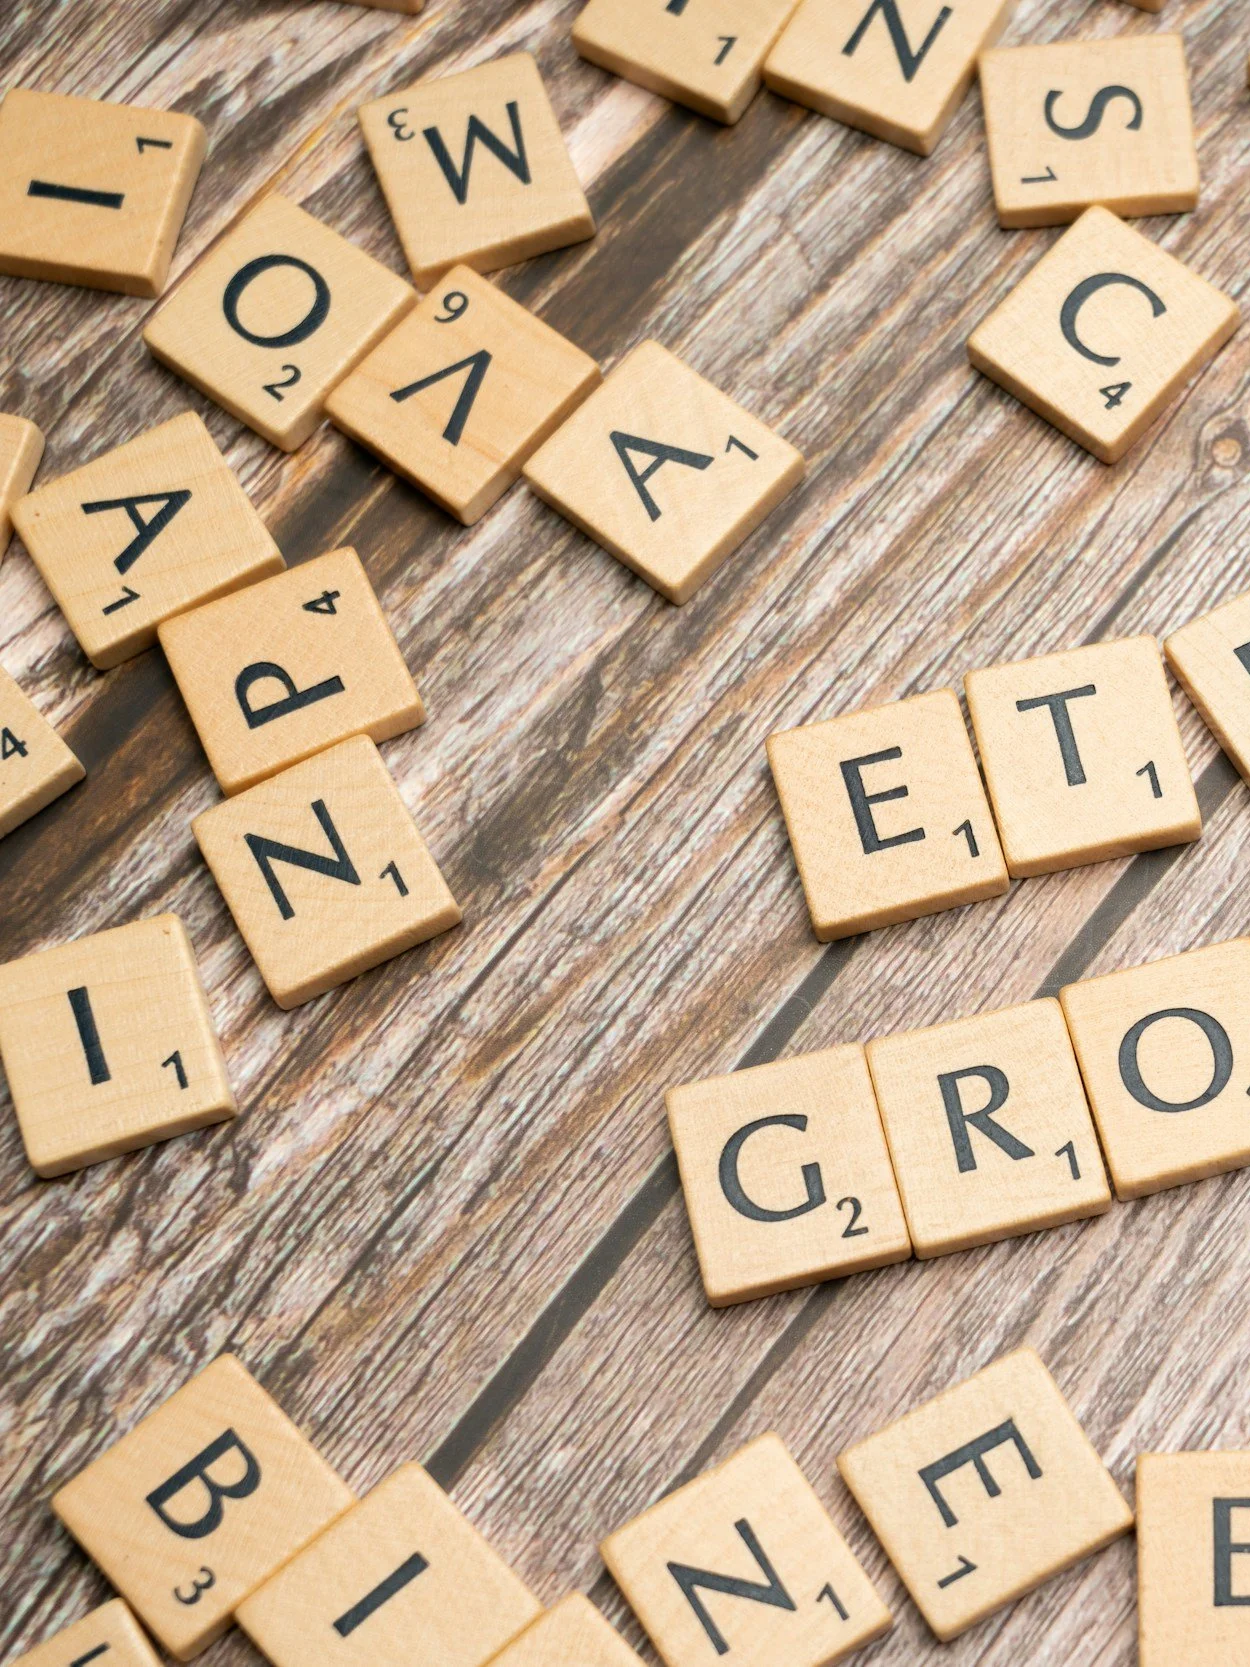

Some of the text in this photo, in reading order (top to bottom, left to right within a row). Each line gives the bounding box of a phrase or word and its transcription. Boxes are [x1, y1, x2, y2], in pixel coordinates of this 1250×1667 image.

[841, 0, 953, 83] N
[1043, 84, 1143, 141] S
[222, 254, 331, 349] O
[1059, 272, 1167, 368] C
[609, 430, 715, 523] A
[80, 489, 193, 576] A
[234, 661, 346, 730] P
[243, 798, 362, 921] N
[66, 985, 111, 1086] I
[144, 1427, 262, 1540] B
[917, 1416, 1044, 1529] E
[666, 1517, 797, 1656] N
